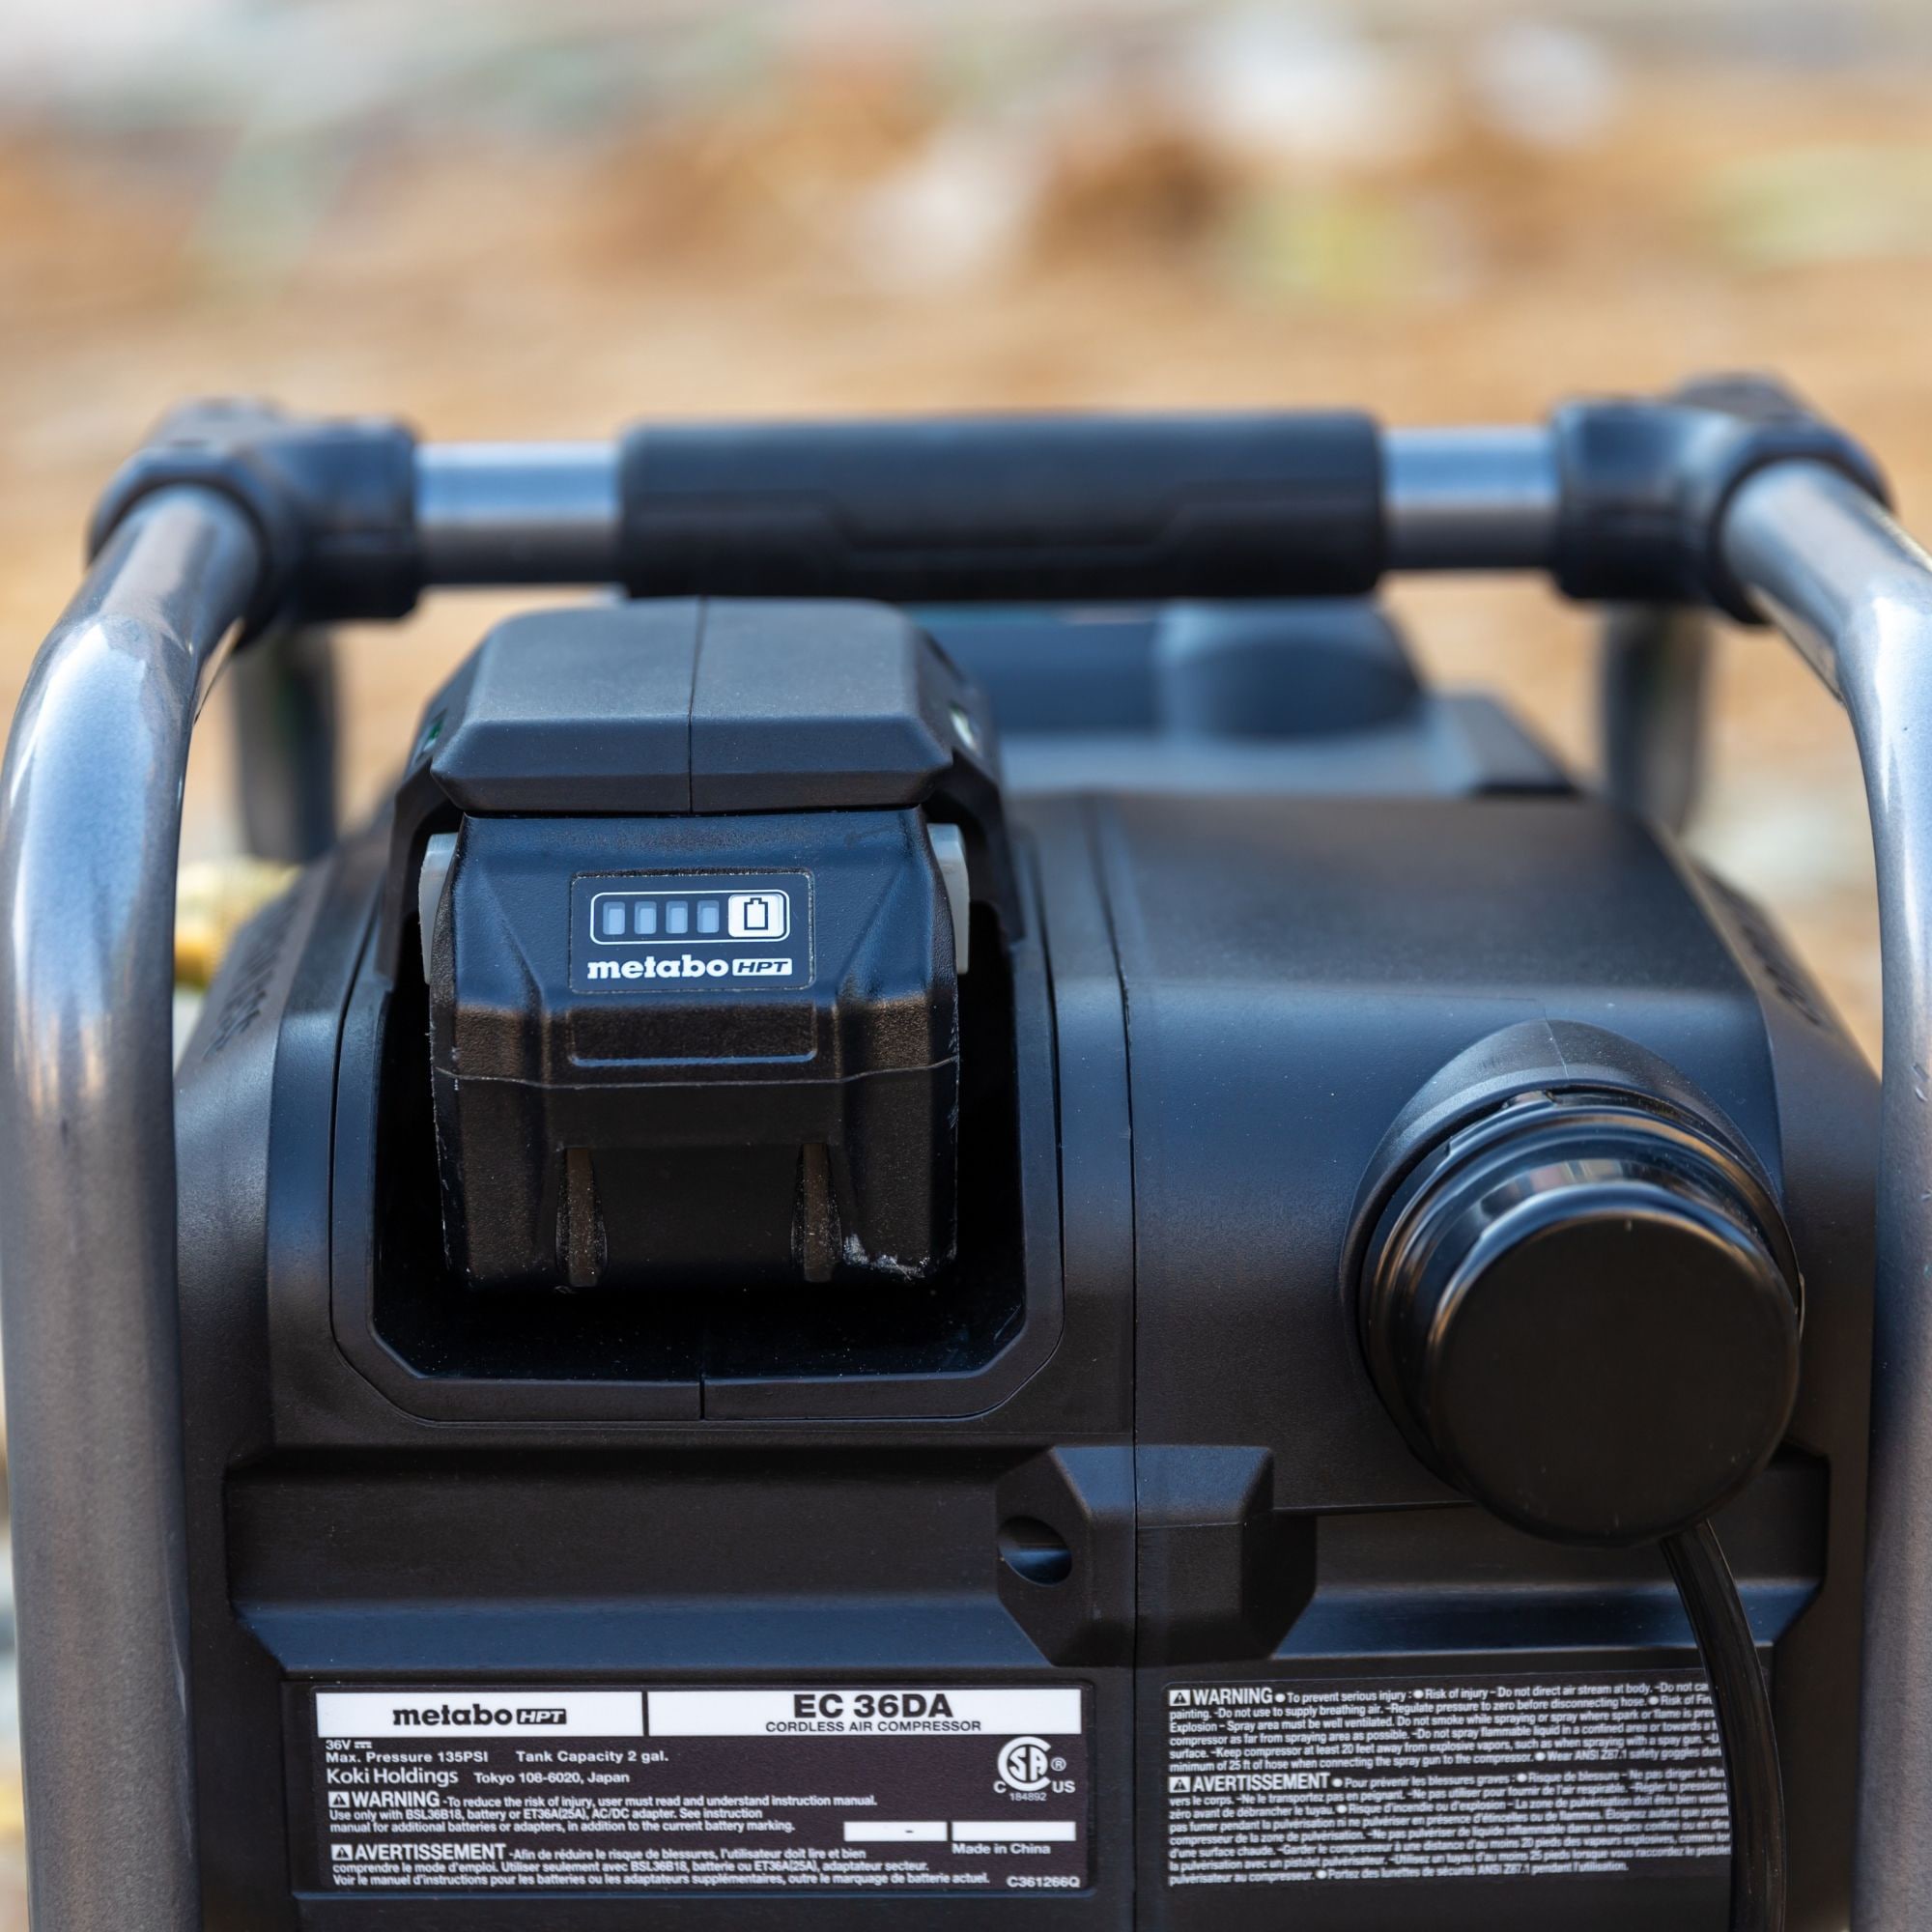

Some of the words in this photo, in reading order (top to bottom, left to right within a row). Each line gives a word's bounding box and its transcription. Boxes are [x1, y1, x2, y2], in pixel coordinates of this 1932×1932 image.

[587, 954, 728, 979] metabo
[735, 960, 790, 974] HPT
[1192, 1687, 1273, 1706] WARNING
[1287, 1692, 1300, 1703] To
[1302, 1692, 1339, 1704] prevent
[1341, 1691, 1378, 1702] serious
[1379, 1690, 1406, 1704] injury
[1425, 1689, 1447, 1699] Risk
[1449, 1689, 1459, 1698] of
[1461, 1689, 1488, 1700] injury
[1498, 1687, 1513, 1697] Do
[1515, 1687, 1530, 1696] not
[1532, 1686, 1561, 1696] direct
[1563, 1686, 1576, 1695] air
[1578, 1685, 1611, 1694] stream
[1613, 1684, 1624, 1694] at
[1626, 1683, 1652, 1694] body.
[1676, 1682, 1692, 1691] not
[794, 1693, 842, 1718] EC
[854, 1693, 952, 1718] 36DA
[392, 1704, 512, 1725] metabo
[518, 1710, 565, 1723] HPT
[766, 1721, 844, 1732] CORDLESS
[849, 1721, 872, 1732] AIR
[878, 1721, 981, 1731] COMPRESSOR
[326, 1741, 351, 1750] 36V
[326, 1752, 361, 1763] Max.
[366, 1752, 433, 1763] Pressure
[438, 1751, 489, 1763] 135PSI
[516, 1750, 553, 1762] Tank
[557, 1750, 623, 1764] Capacity
[628, 1750, 637, 1762] 2
[641, 1750, 668, 1764] gal.
[327, 1768, 369, 1784] Koki
[374, 1768, 459, 1787] Holdings
[473, 1773, 515, 1785] Tokyo
[519, 1772, 583, 1784] 108-6020,
[587, 1772, 630, 1784] Japan
[1192, 1772, 1330, 1793] AVERTISSEMENT
[1052, 1781, 1076, 1793] US
[352, 1791, 440, 1807] WARNING
[464, 1797, 501, 1807] reduce
[504, 1797, 522, 1807] the
[525, 1797, 545, 1807] risk
[548, 1797, 559, 1806] of
[561, 1797, 595, 1809] injury,
[626, 1797, 653, 1806] must
[656, 1797, 680, 1806] read
[683, 1797, 703, 1806] and
[707, 1795, 769, 1806] understand
[772, 1795, 831, 1805] instruction
[833, 1795, 877, 1805] manual.
[329, 1810, 351, 1820] Use
[354, 1810, 377, 1822] only
[380, 1809, 403, 1820] with
[406, 1809, 465, 1821] BSL36B18,
[468, 1808, 506, 1822] battery
[509, 1810, 521, 1820] or
[524, 1808, 589, 1820] ET36A(25A),
[591, 1808, 629, 1820] AC/DC
[632, 1808, 676, 1820] adapter.
[680, 1808, 701, 1818] See
[703, 1808, 763, 1818] instruction
[330, 1822, 371, 1833] manual
[373, 1822, 389, 1833] for
[391, 1822, 445, 1832] additional
[448, 1822, 497, 1832] batteries
[514, 1822, 566, 1833] adapters,
[568, 1822, 578, 1832] in
[581, 1821, 625, 1832] addition
[628, 1822, 639, 1832] to
[641, 1821, 660, 1832] the
[663, 1822, 703, 1832] current
[705, 1821, 744, 1833] battery
[747, 1820, 796, 1833] marking.
[355, 1843, 506, 1861] AVERTISSEMENT
[537, 1849, 552, 1860] de
[595, 1849, 606, 1860] le
[609, 1849, 643, 1861] risque
[645, 1849, 659, 1859] de
[662, 1849, 719, 1861] blessures,
[784, 1848, 806, 1859] doit
[808, 1848, 826, 1859] lire
[828, 1849, 839, 1859] et
[842, 1848, 866, 1859] bien
[952, 1843, 990, 1854] Made
[995, 1843, 1007, 1854] in
[1010, 1843, 1051, 1854] China
[332, 1862, 400, 1874] comprendre
[402, 1862, 412, 1873] le
[414, 1862, 444, 1872] mode
[501, 1862, 540, 1872] Utiliser
[543, 1861, 600, 1872] seulement
[603, 1862, 628, 1872] avec
[692, 1861, 734, 1872] batterie
[738, 1862, 752, 1872] ou
[822, 1861, 881, 1872] adaptateur
[885, 1861, 929, 1871] secteur.
